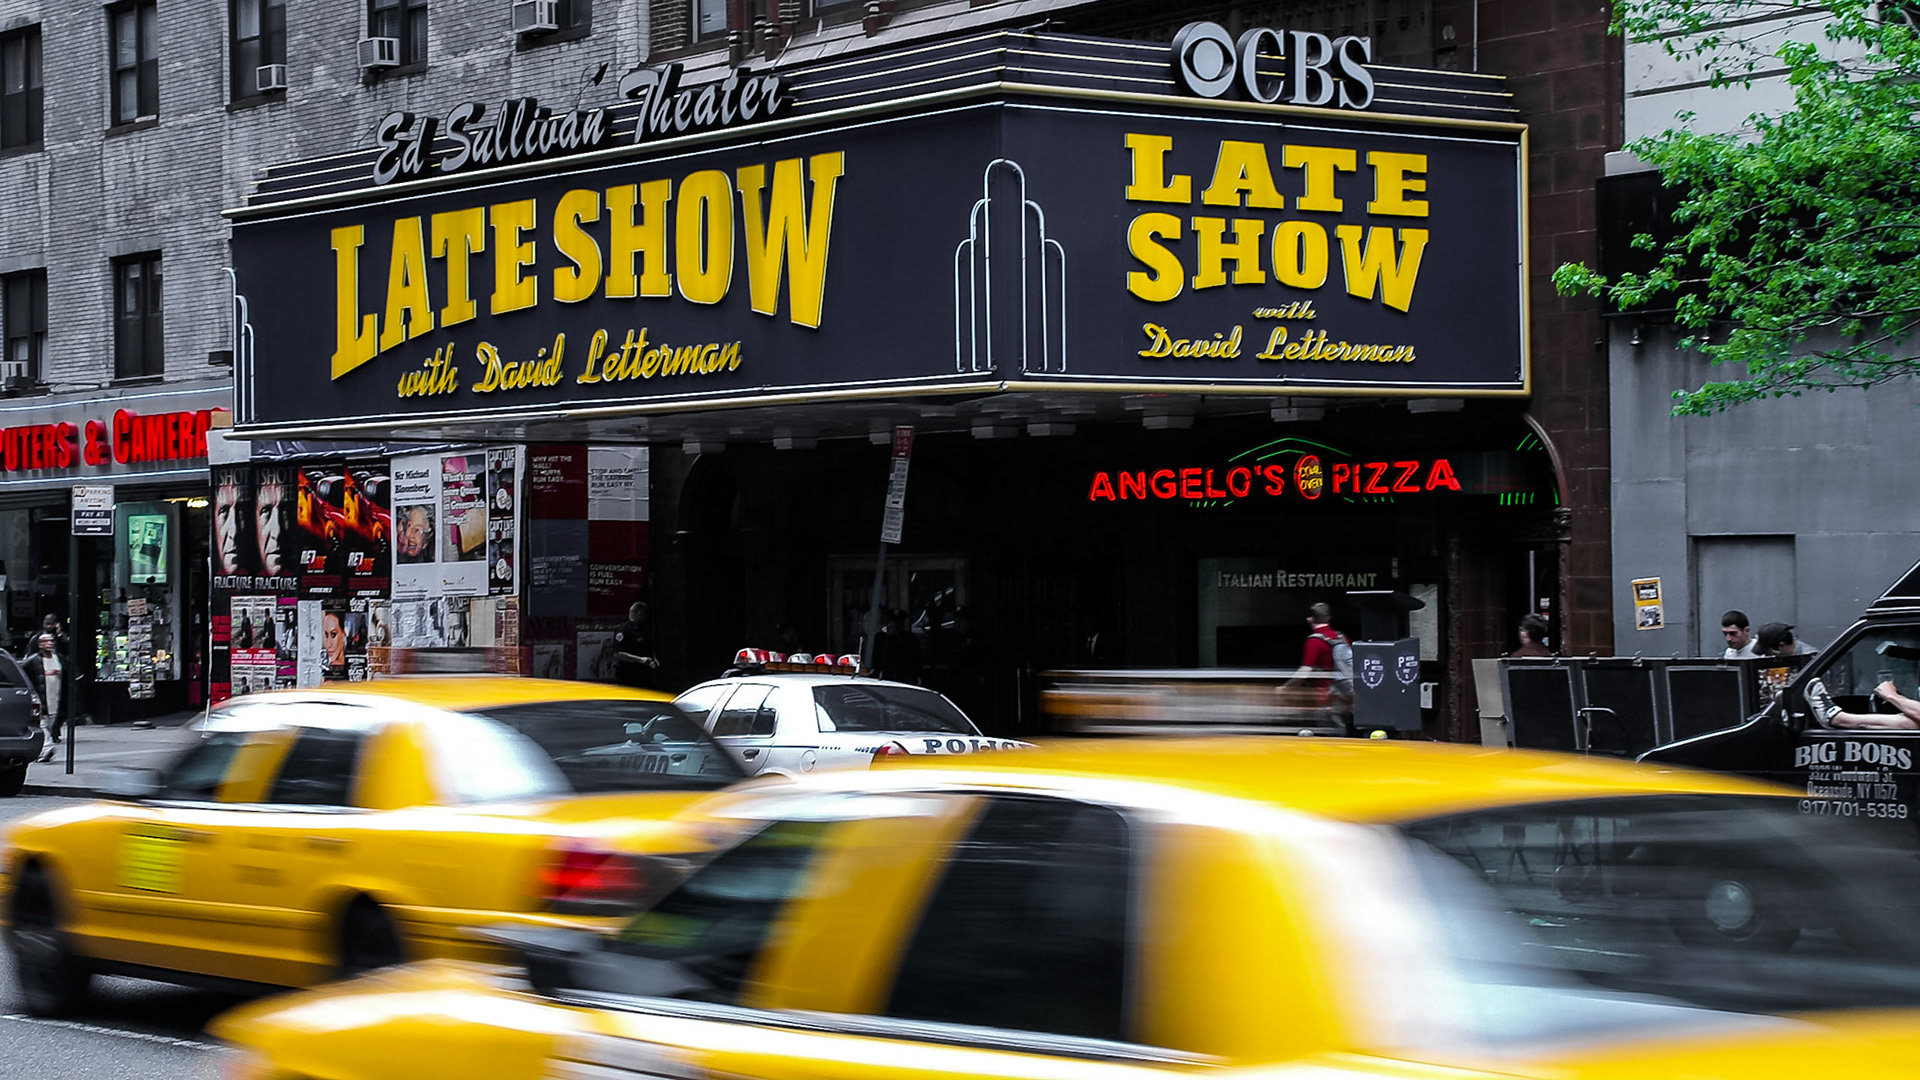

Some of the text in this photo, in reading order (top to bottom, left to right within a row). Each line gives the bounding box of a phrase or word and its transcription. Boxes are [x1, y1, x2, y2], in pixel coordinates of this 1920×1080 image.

[1238, 28, 1374, 109] CBS
[374, 65, 784, 185] Ed Sullivan Theater
[1125, 133, 1429, 217] LATE
[331, 151, 845, 381] LATE SHOW
[1127, 212, 1429, 313] SHOW
[1252, 300, 1316, 320] with
[398, 327, 742, 399] with David Letterman
[1138, 322, 1416, 362] David Letterman
[0, 422, 77, 472] UTERS
[85, 420, 109, 466] &
[1089, 459, 1463, 501] ANGELO'S PIZZA
[213, 576, 253, 589] FRACTURE
[255, 577, 298, 590] FRACTURE
[590, 563, 642, 573] CONVERSATION
[1795, 741, 1912, 770] BIG BOBS
[1857, 783, 1872, 799] NY
